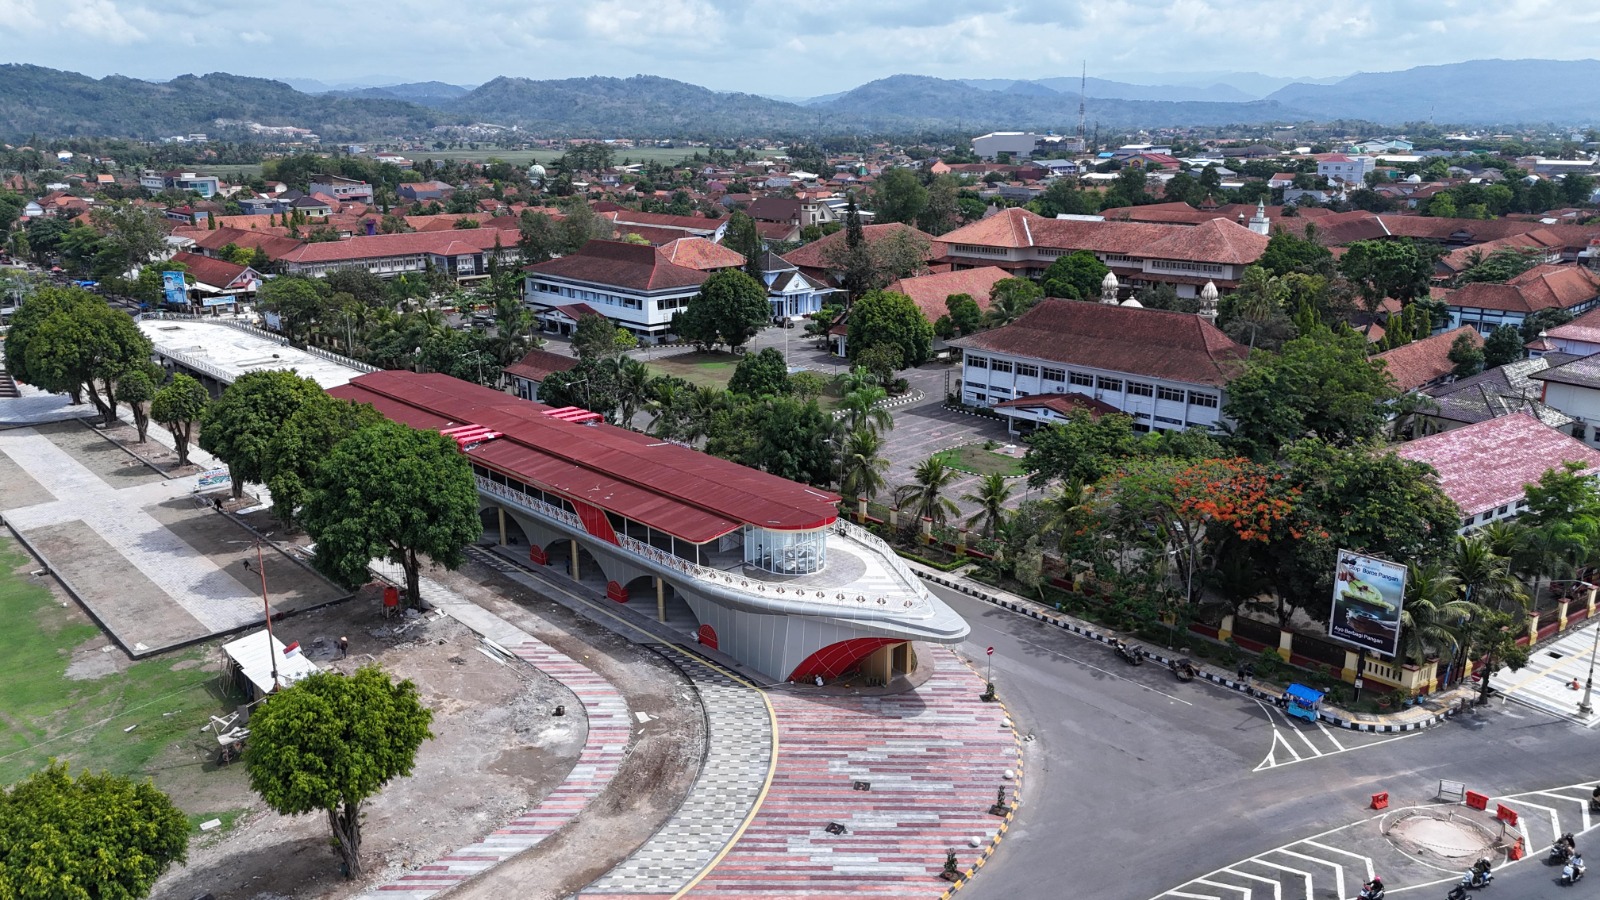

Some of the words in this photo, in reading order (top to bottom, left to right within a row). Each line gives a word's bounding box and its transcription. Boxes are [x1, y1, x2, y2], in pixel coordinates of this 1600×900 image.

[1349, 564, 1360, 572] Stop
[1362, 567, 1378, 577] Boros
[1378, 571, 1399, 582] Pangan
[1334, 625, 1344, 633] Ayo
[1344, 627, 1364, 639] Berbagi
[1363, 634, 1383, 644] Pangan
